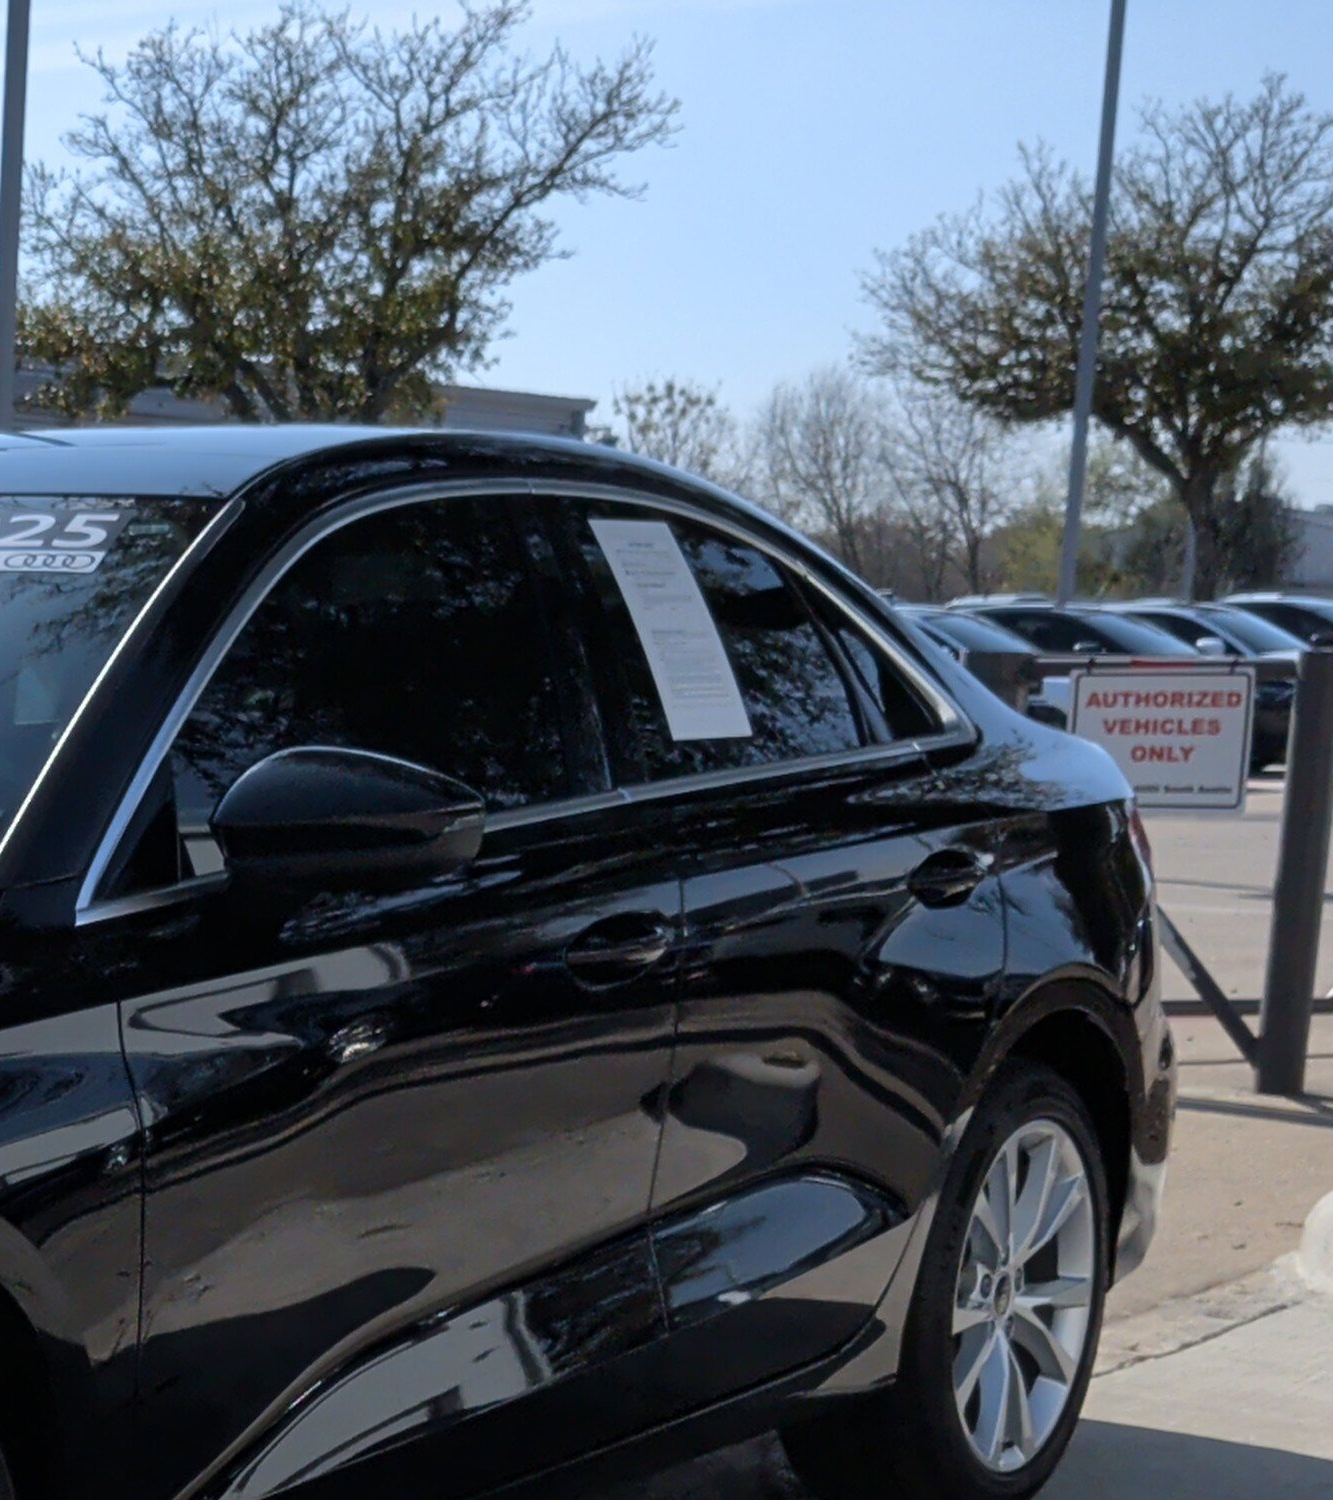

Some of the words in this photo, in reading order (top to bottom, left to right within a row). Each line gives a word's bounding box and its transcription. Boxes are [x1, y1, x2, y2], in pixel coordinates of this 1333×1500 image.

[1086, 691, 1243, 709] AUTHORIZED
[1103, 717, 1222, 736] VEHICLES
[1131, 746, 1196, 763] ONLY
